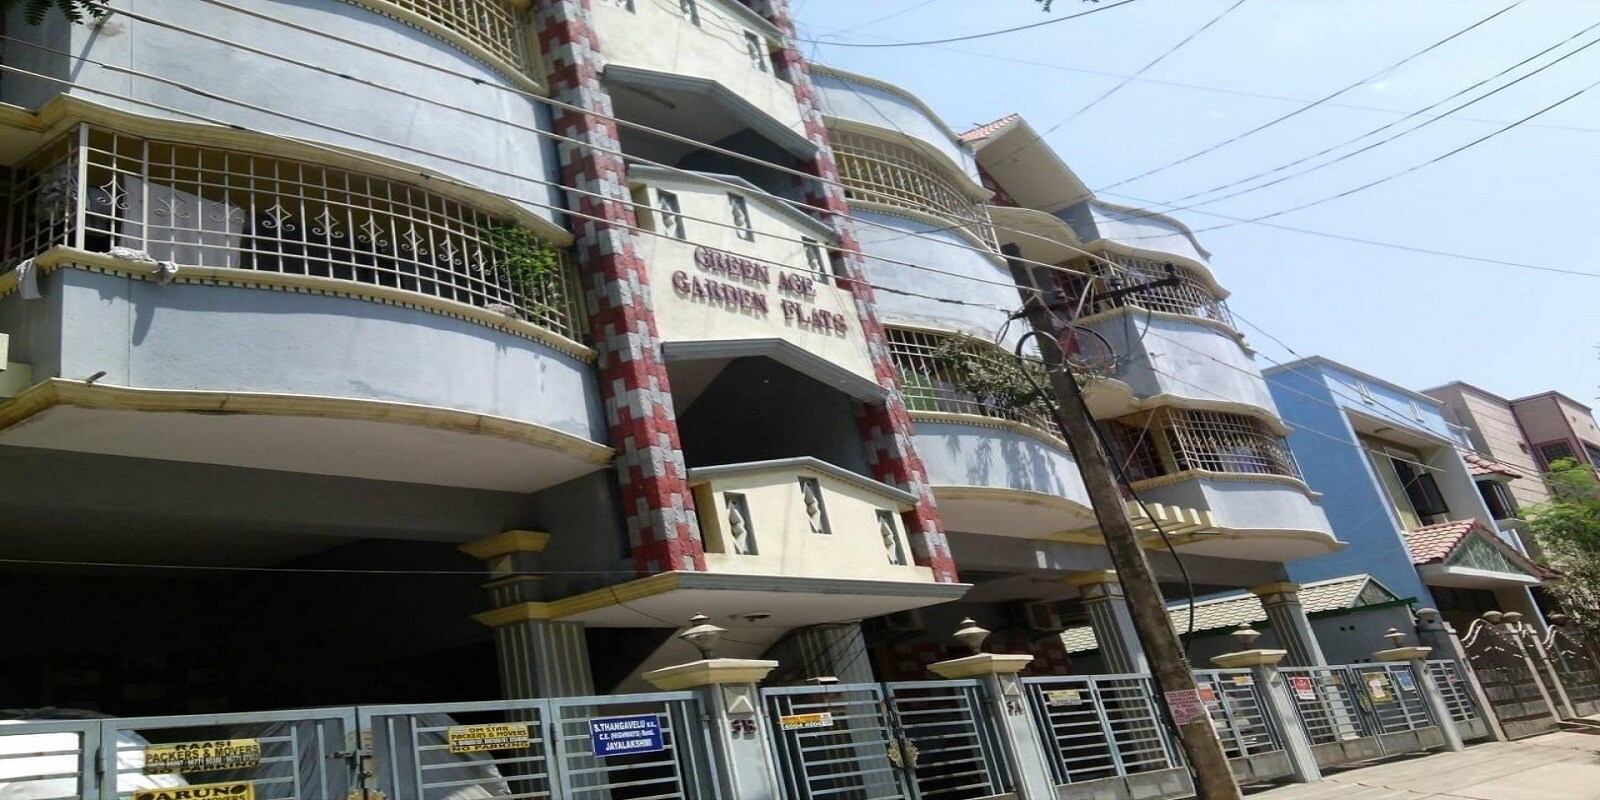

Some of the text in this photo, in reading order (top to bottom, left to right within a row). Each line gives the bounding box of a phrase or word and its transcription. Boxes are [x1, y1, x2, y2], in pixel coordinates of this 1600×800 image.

[694, 246, 817, 296] GREEN AGE
[672, 270, 849, 333] GARDEN FLATS
[175, 740, 231, 750] RAASI
[475, 742, 529, 750] PARKING
[605, 738, 653, 751] JAYALAKSHMI
[146, 744, 260, 763] PACKERS & MOVERS
[180, 760, 258, 772] PARKING
[154, 786, 230, 800] ARUN
